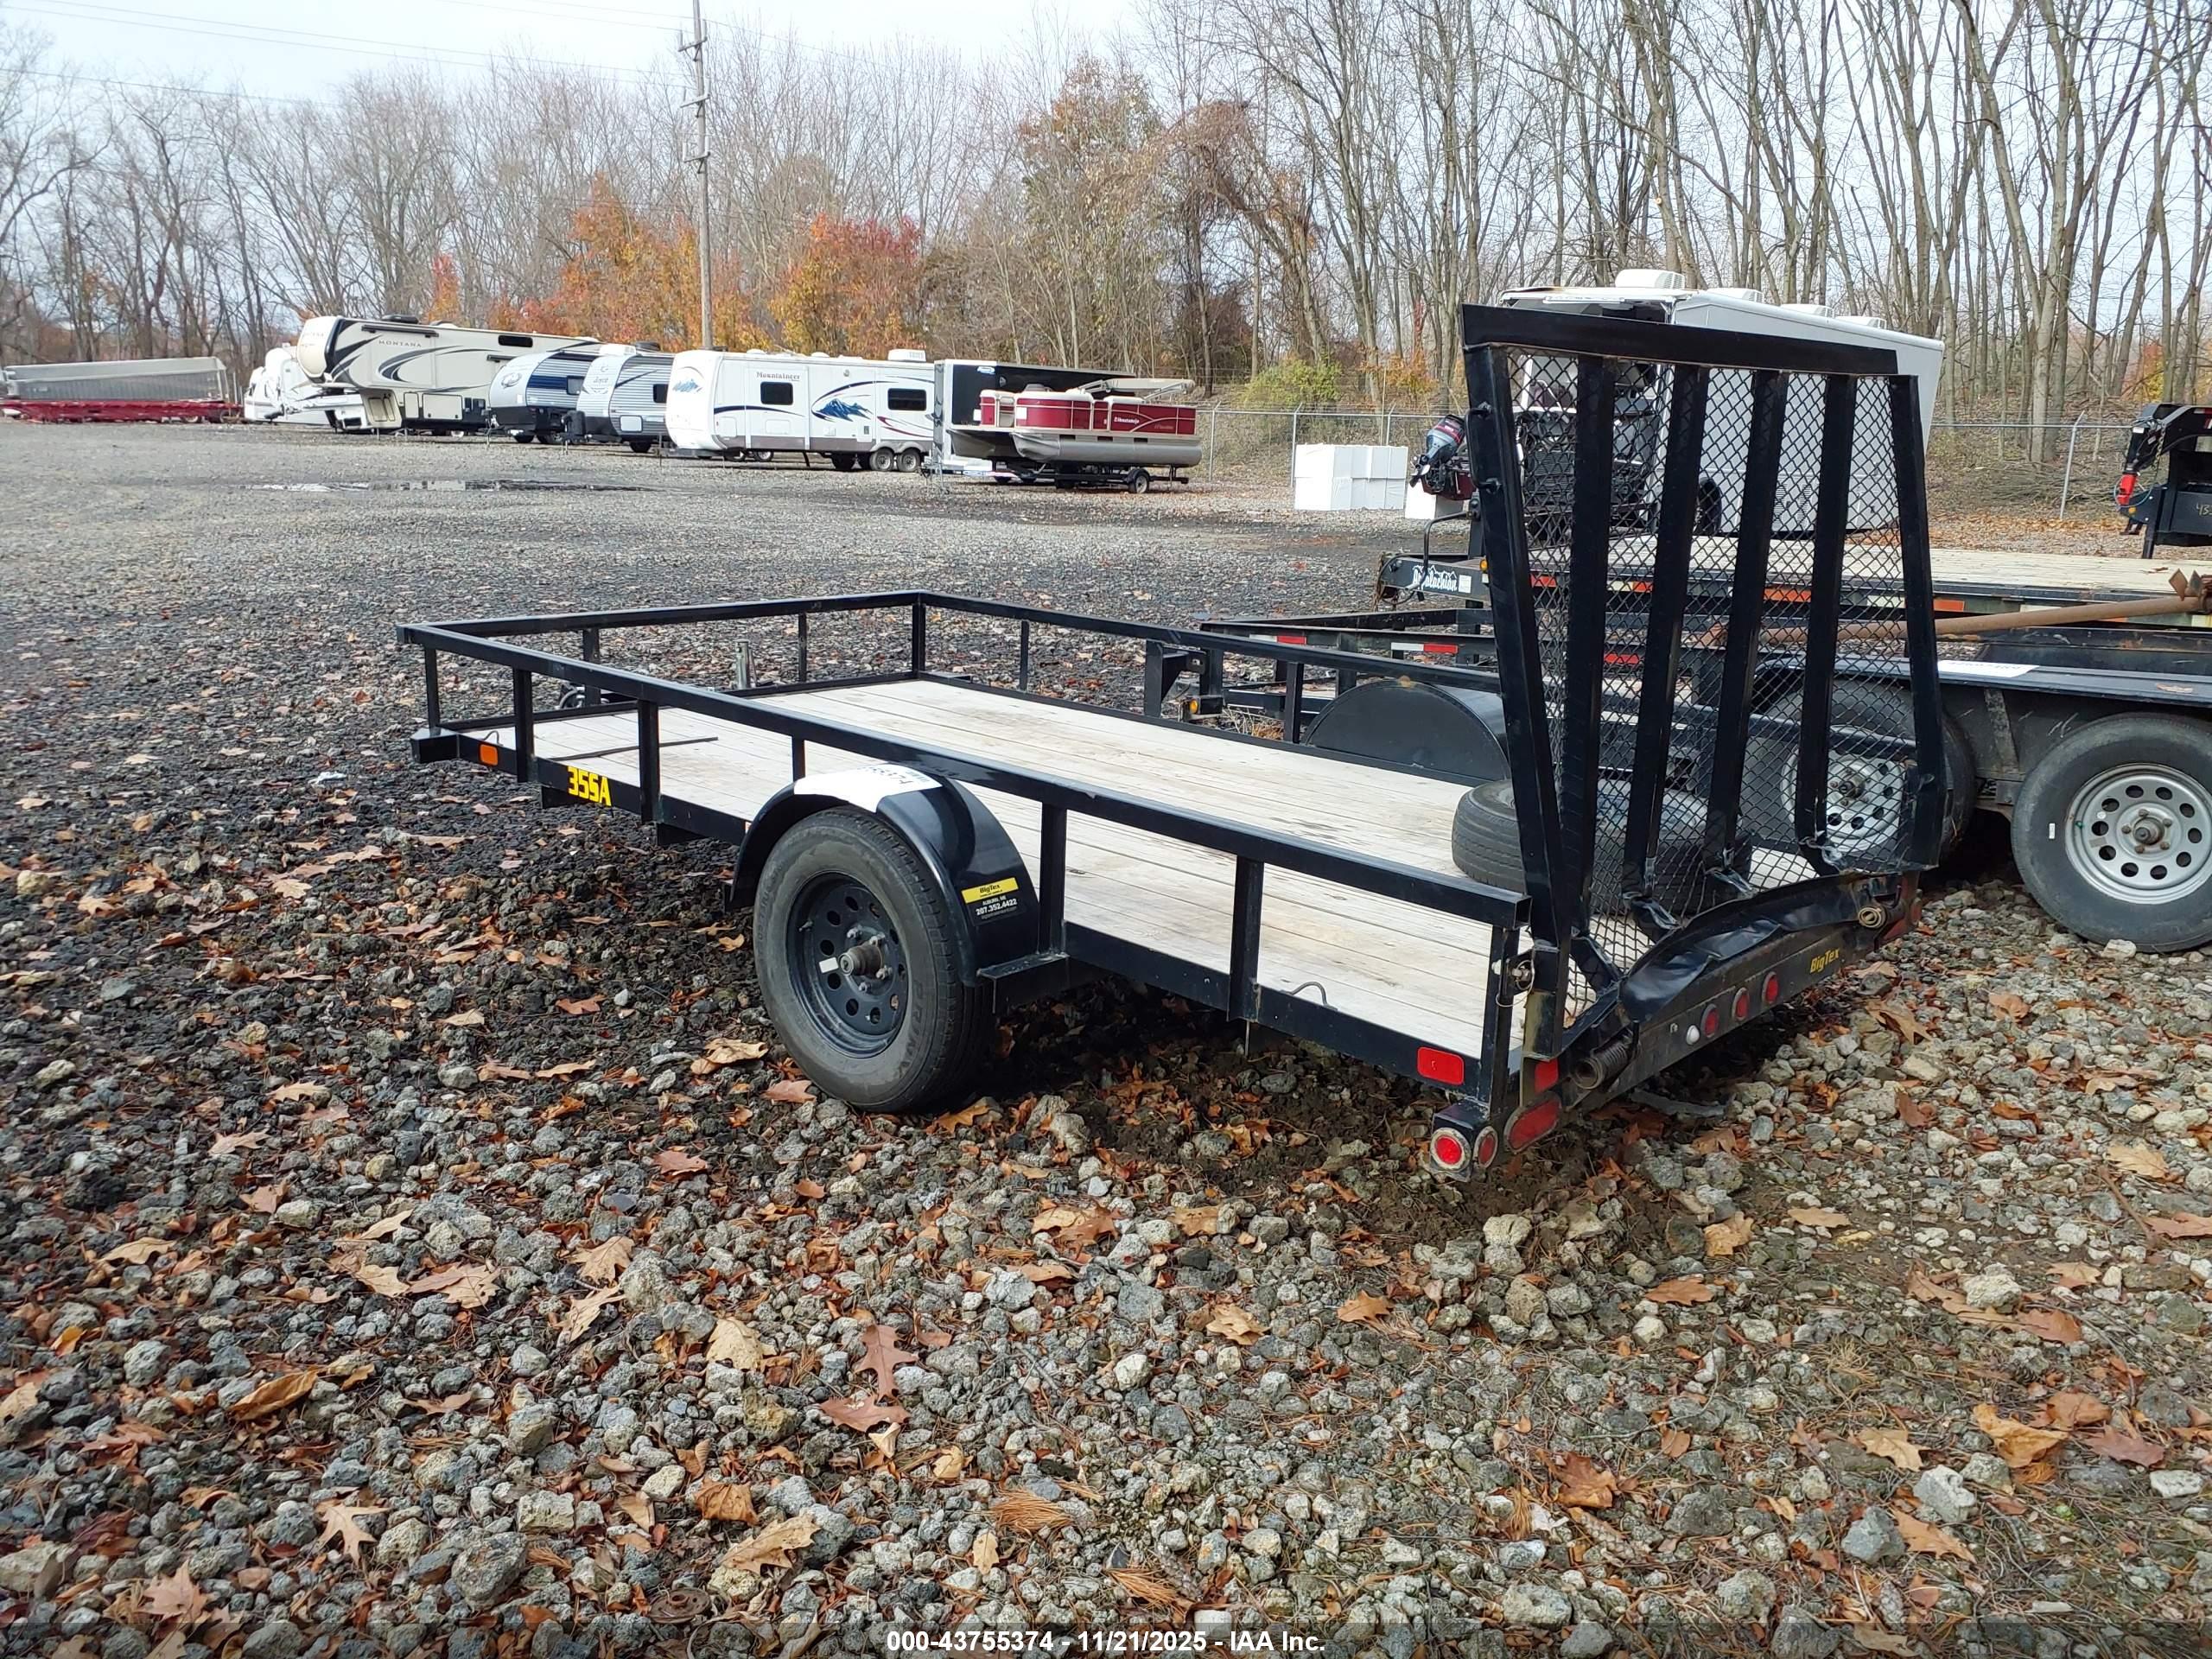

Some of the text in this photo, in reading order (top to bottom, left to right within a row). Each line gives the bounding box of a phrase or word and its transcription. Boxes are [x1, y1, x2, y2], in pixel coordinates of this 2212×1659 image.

[756, 372, 800, 380] Mountaineer
[980, 884, 1001, 893] BigTex
[976, 898, 1018, 916] 207.352.4422
[1810, 948, 1840, 974] BigTex
